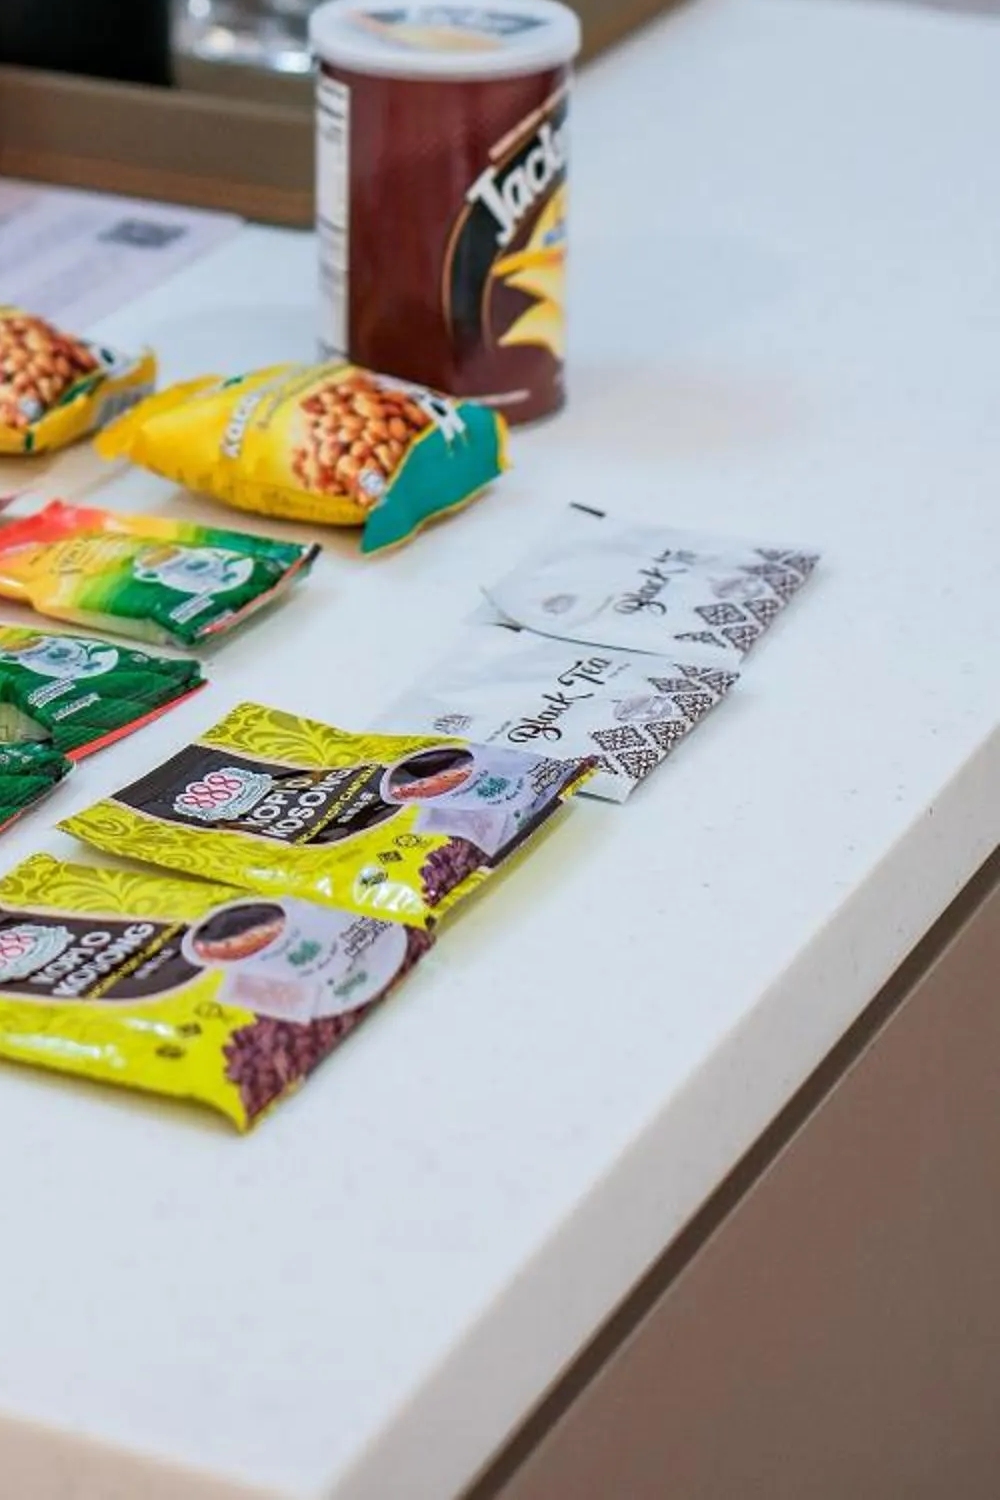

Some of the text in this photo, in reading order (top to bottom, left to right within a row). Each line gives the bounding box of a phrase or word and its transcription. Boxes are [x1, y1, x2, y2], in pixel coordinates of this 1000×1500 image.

[508, 691, 594, 742] Black
[557, 657, 612, 686] Tea
[182, 772, 243, 809] 888
[241, 789, 299, 828] KOPI
[261, 769, 354, 838] KOSONG
[52, 923, 155, 997] KOSONG
